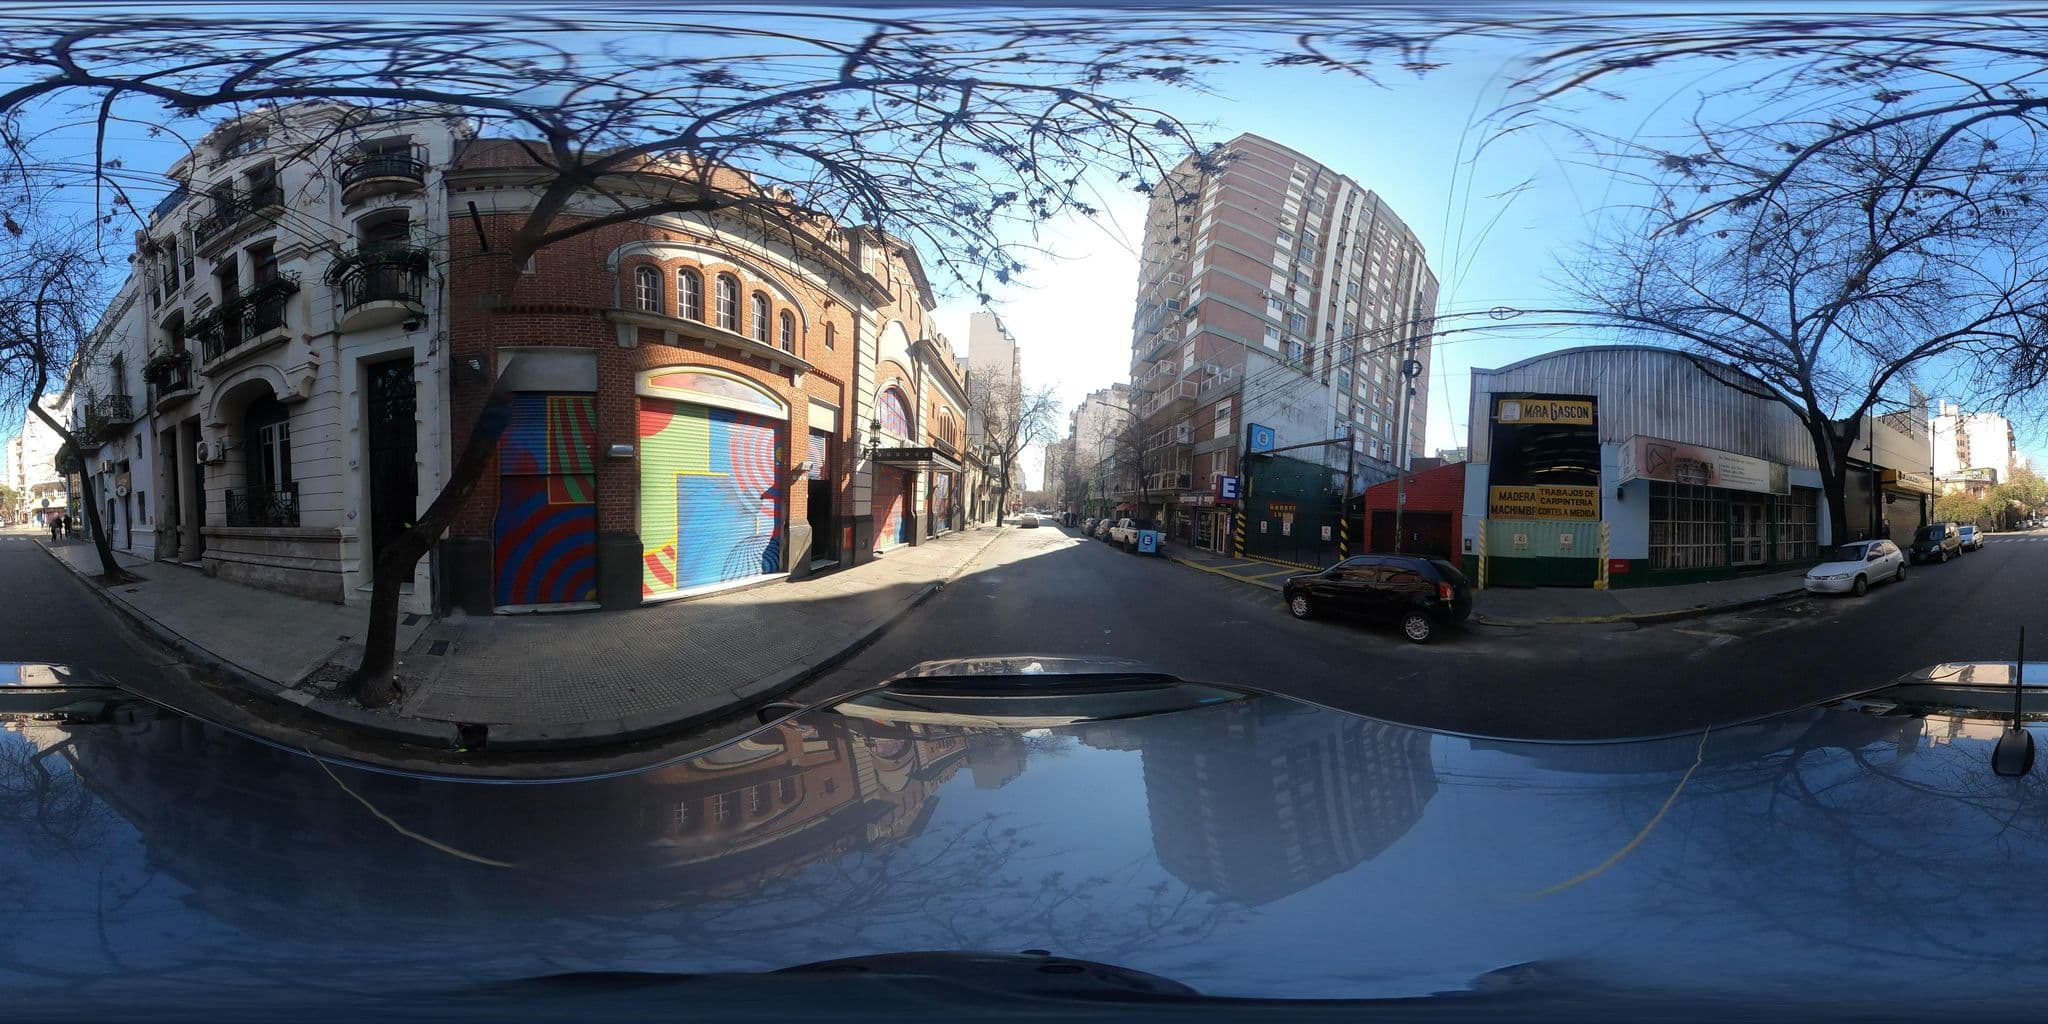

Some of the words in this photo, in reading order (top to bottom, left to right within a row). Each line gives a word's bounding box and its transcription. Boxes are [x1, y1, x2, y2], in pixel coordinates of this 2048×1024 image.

[1550, 403, 1589, 421] GASCON
[1223, 477, 1236, 498] E
[1540, 488, 1584, 497] TRABAJOS
[1584, 490, 1595, 498] DE
[1498, 491, 1536, 502] MADERA
[1540, 497, 1593, 507] CARPINTERIA
[1537, 507, 1561, 516] CORTES
[1561, 508, 1568, 517] A
[1569, 509, 1596, 518] MEDIDA
